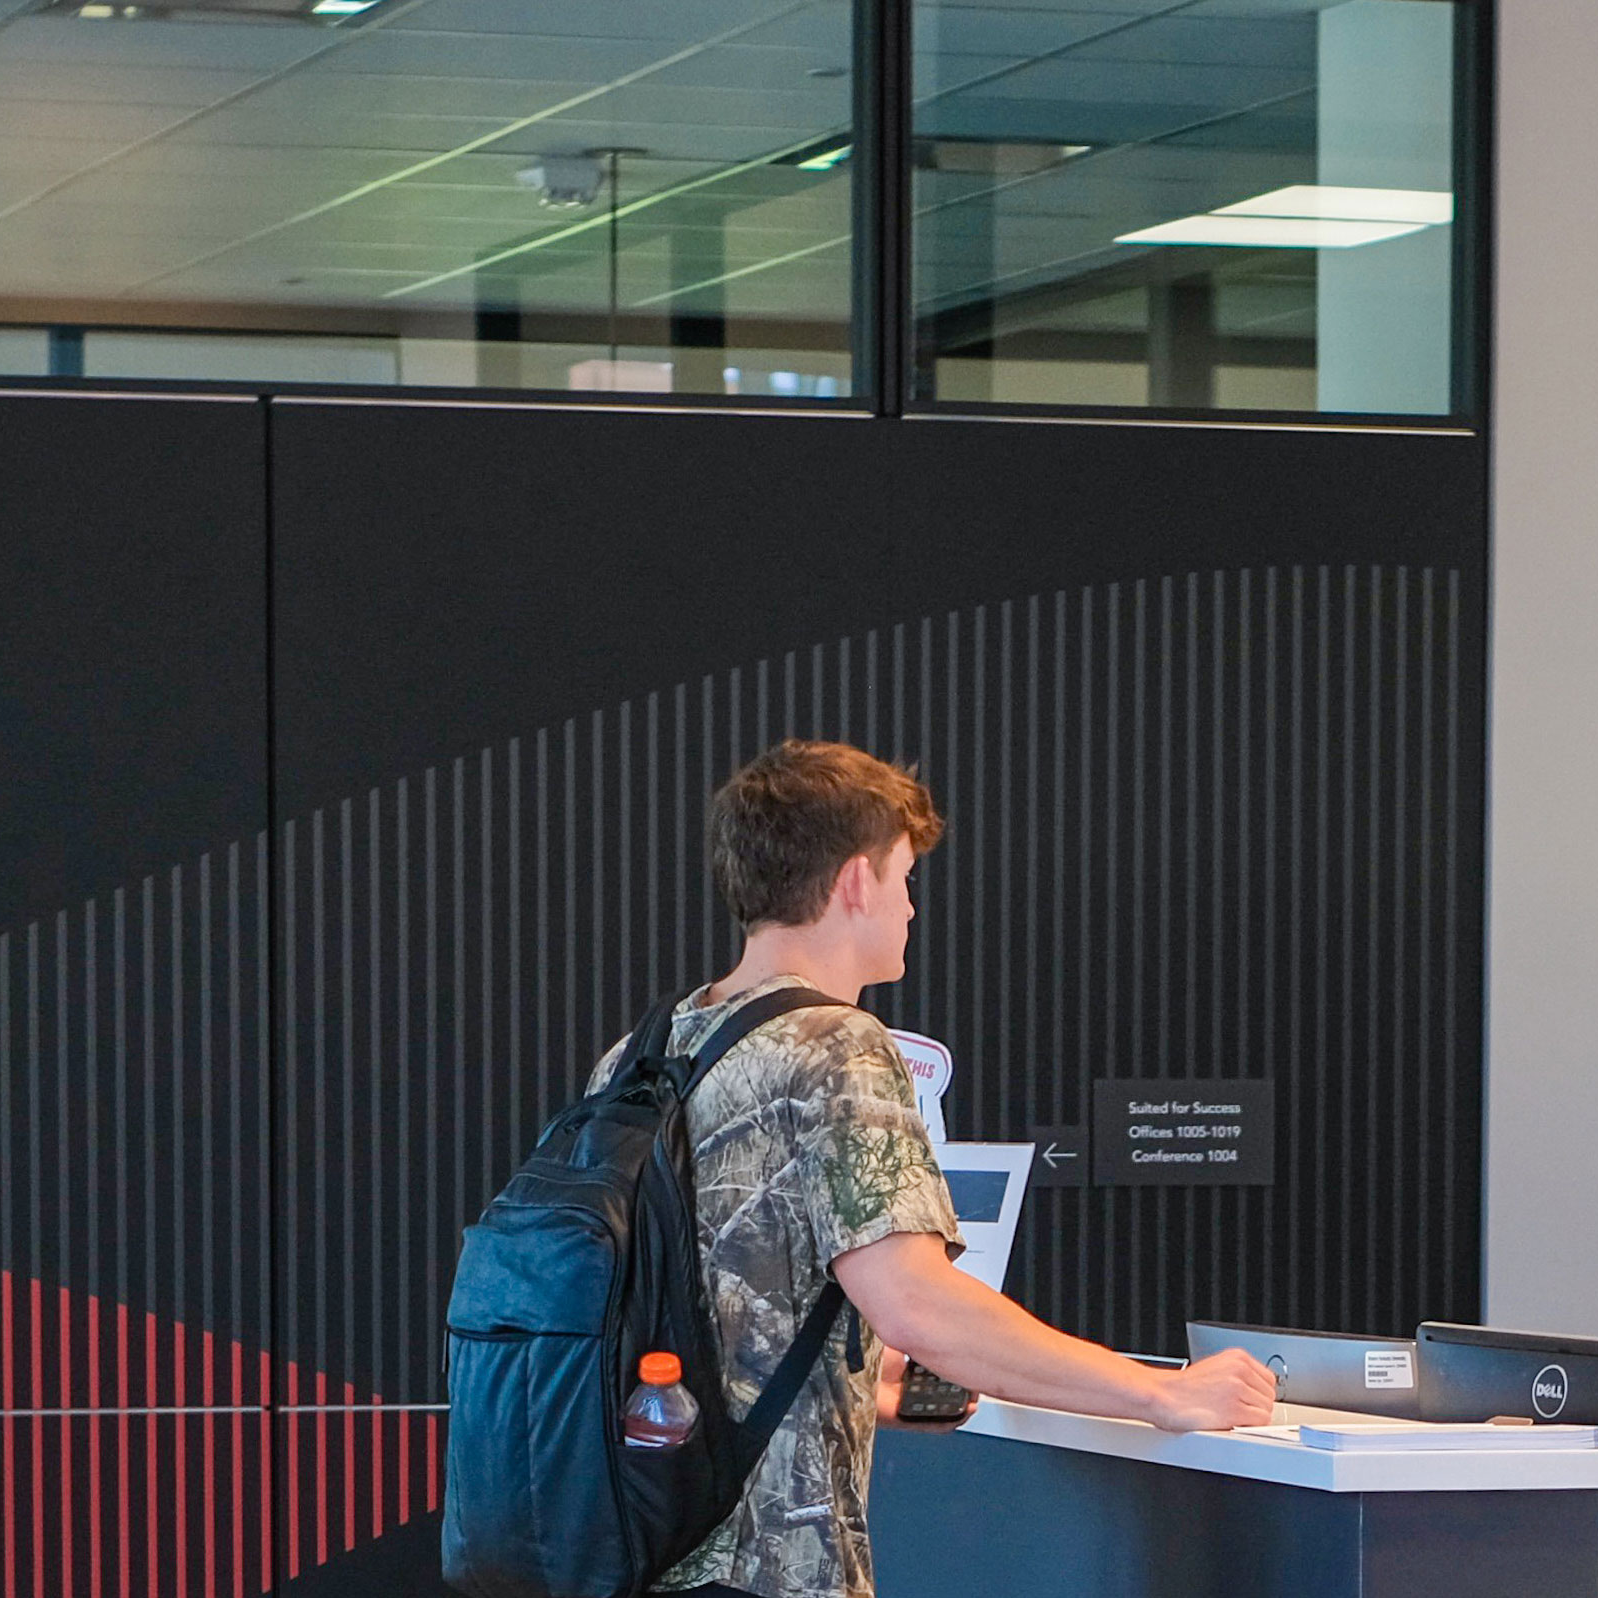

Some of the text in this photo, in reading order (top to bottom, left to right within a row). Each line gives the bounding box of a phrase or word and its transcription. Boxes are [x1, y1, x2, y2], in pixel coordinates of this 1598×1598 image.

[1128, 1101, 1241, 1115] Suited for Success
[1128, 1125, 1241, 1139] Offices 1005-1019
[1131, 1149, 1239, 1163] Conference 1004
[1536, 1383, 1563, 1399] DELL
